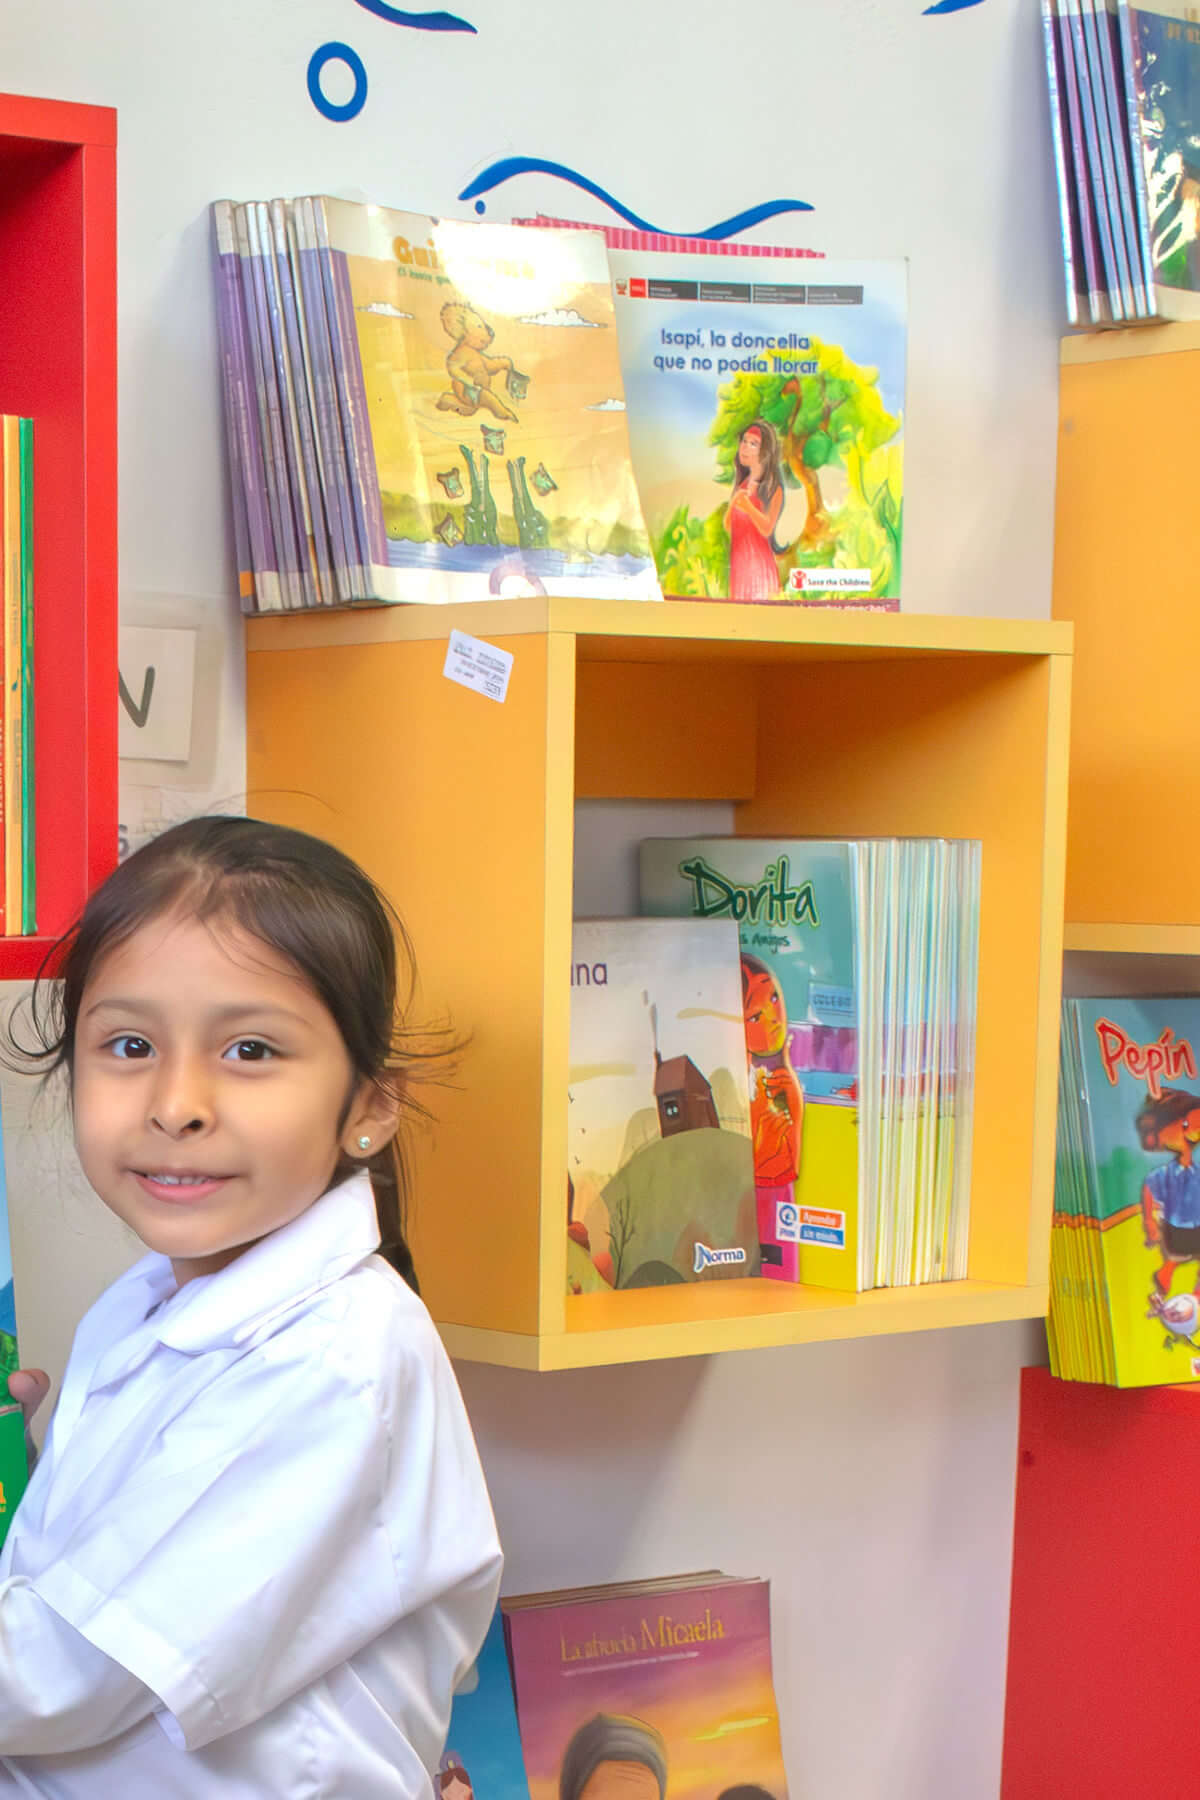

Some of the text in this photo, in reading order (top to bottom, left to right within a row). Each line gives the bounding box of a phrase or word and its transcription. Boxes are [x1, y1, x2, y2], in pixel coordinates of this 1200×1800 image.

[710, 330, 726, 347] la
[731, 332, 810, 350] doncella
[653, 354, 818, 374] que no podía llorar
[681, 859, 819, 925] Dorita
[571, 963, 607, 986] na
[1098, 1021, 1197, 1096] Pepín
[694, 1243, 744, 1272] Norma
[640, 1608, 726, 1649] Micaela
